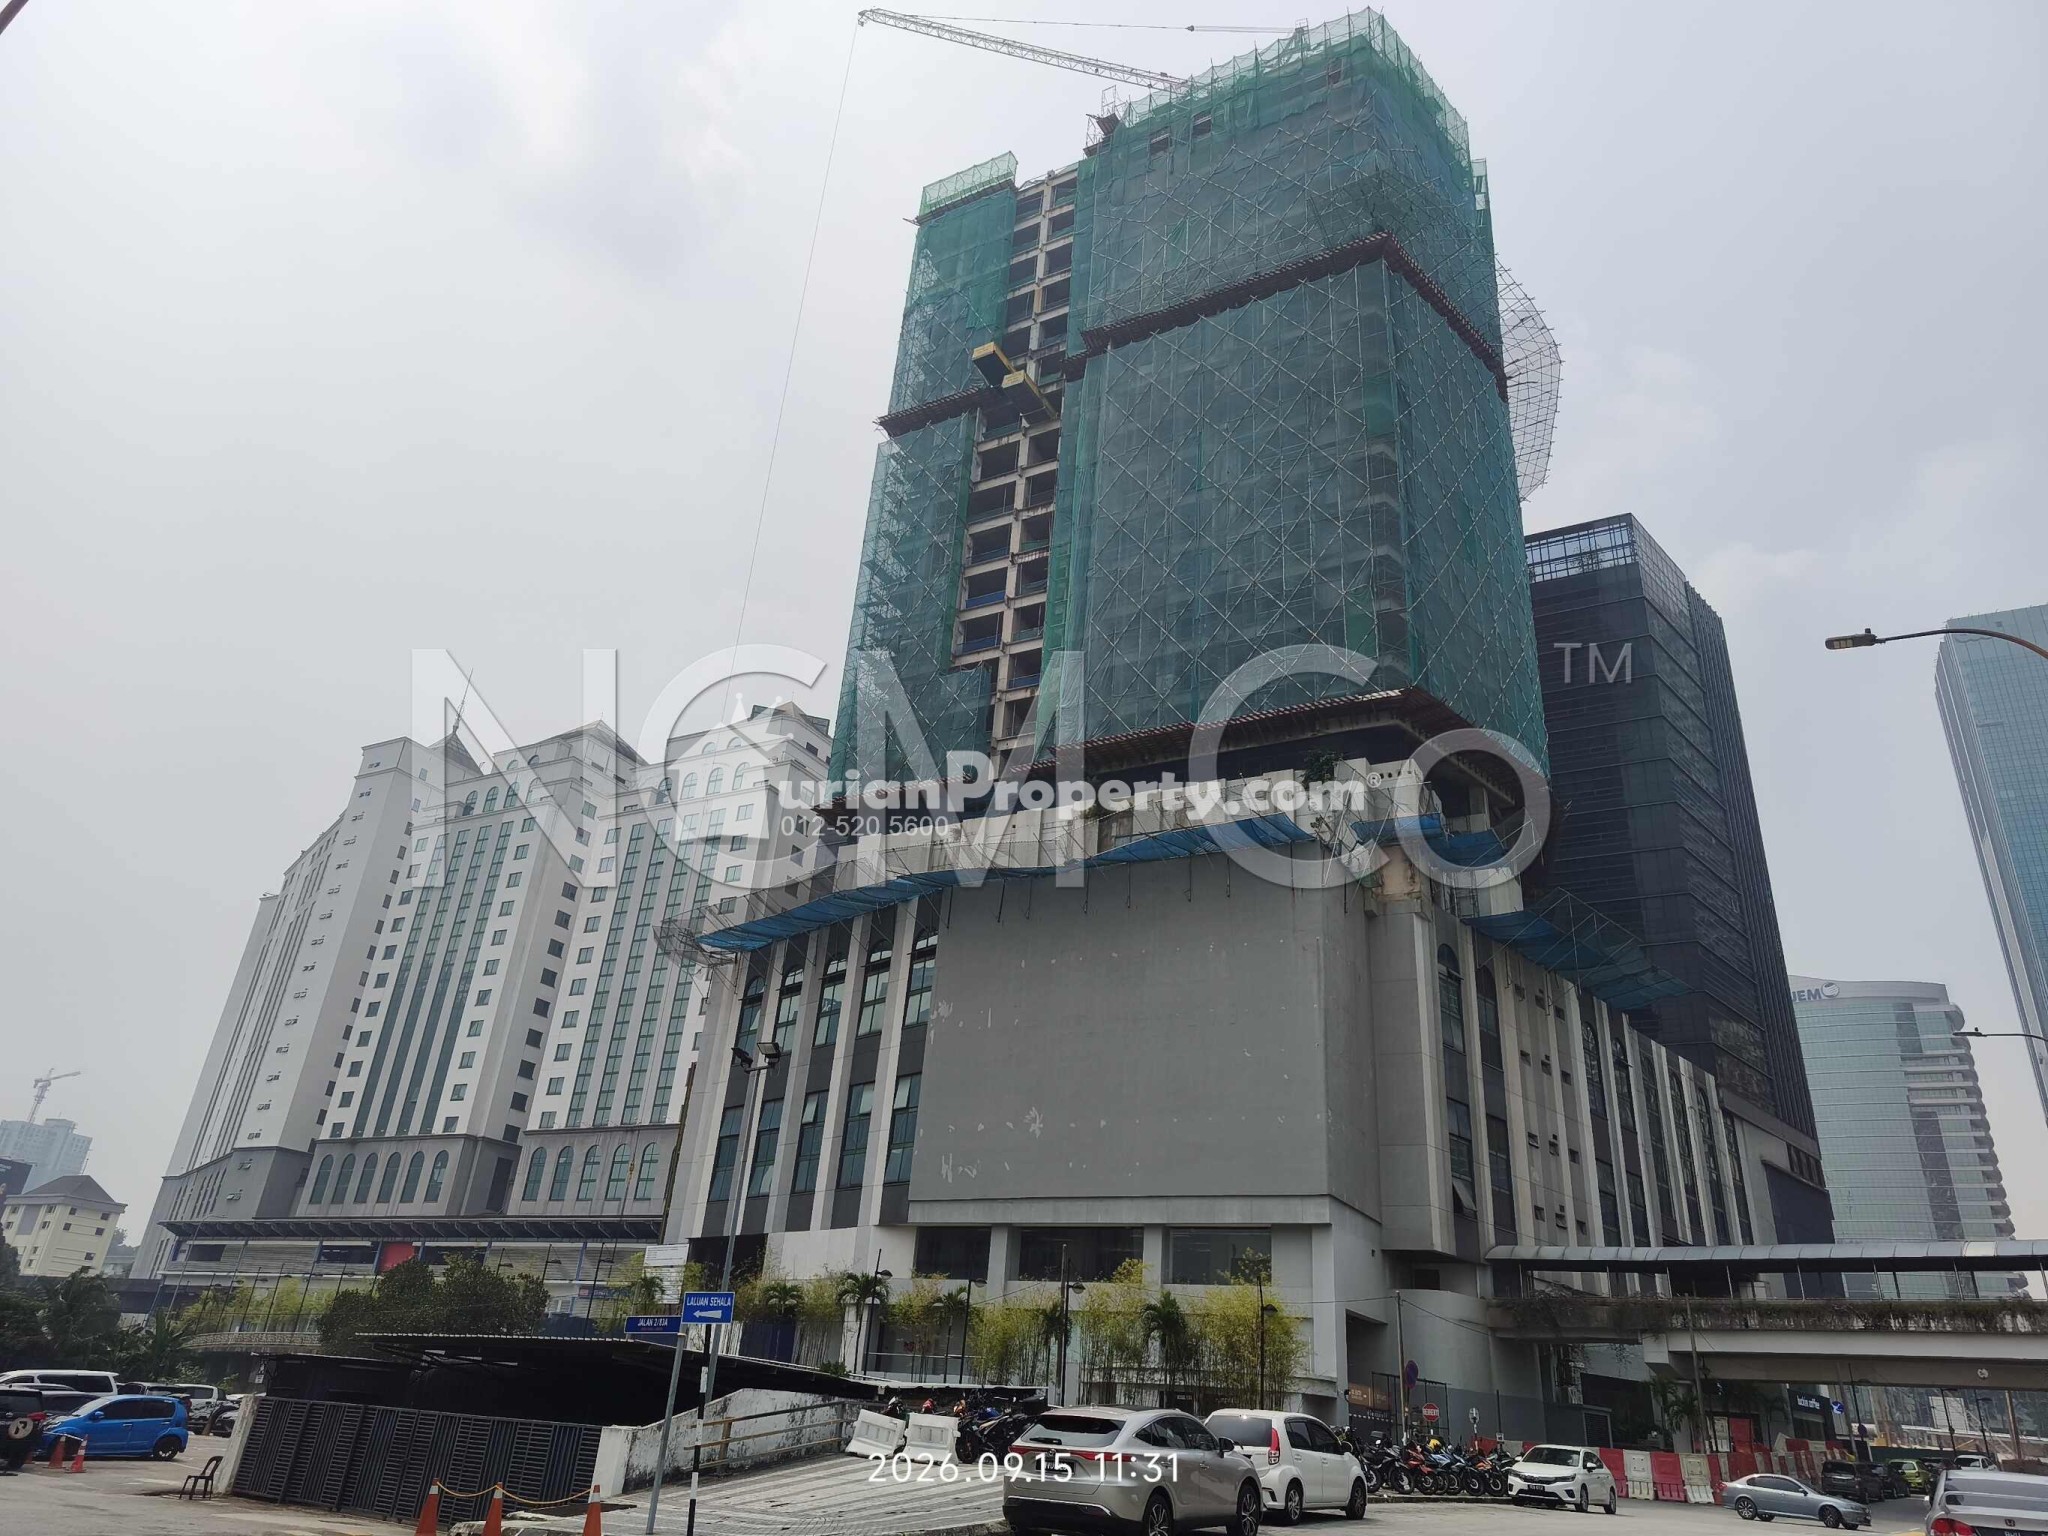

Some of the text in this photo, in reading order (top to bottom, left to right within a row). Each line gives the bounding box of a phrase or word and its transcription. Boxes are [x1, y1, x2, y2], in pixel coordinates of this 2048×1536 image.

[687, 1297, 731, 1306] LALUAN SEHALA
[638, 1318, 653, 1327] JALAN
